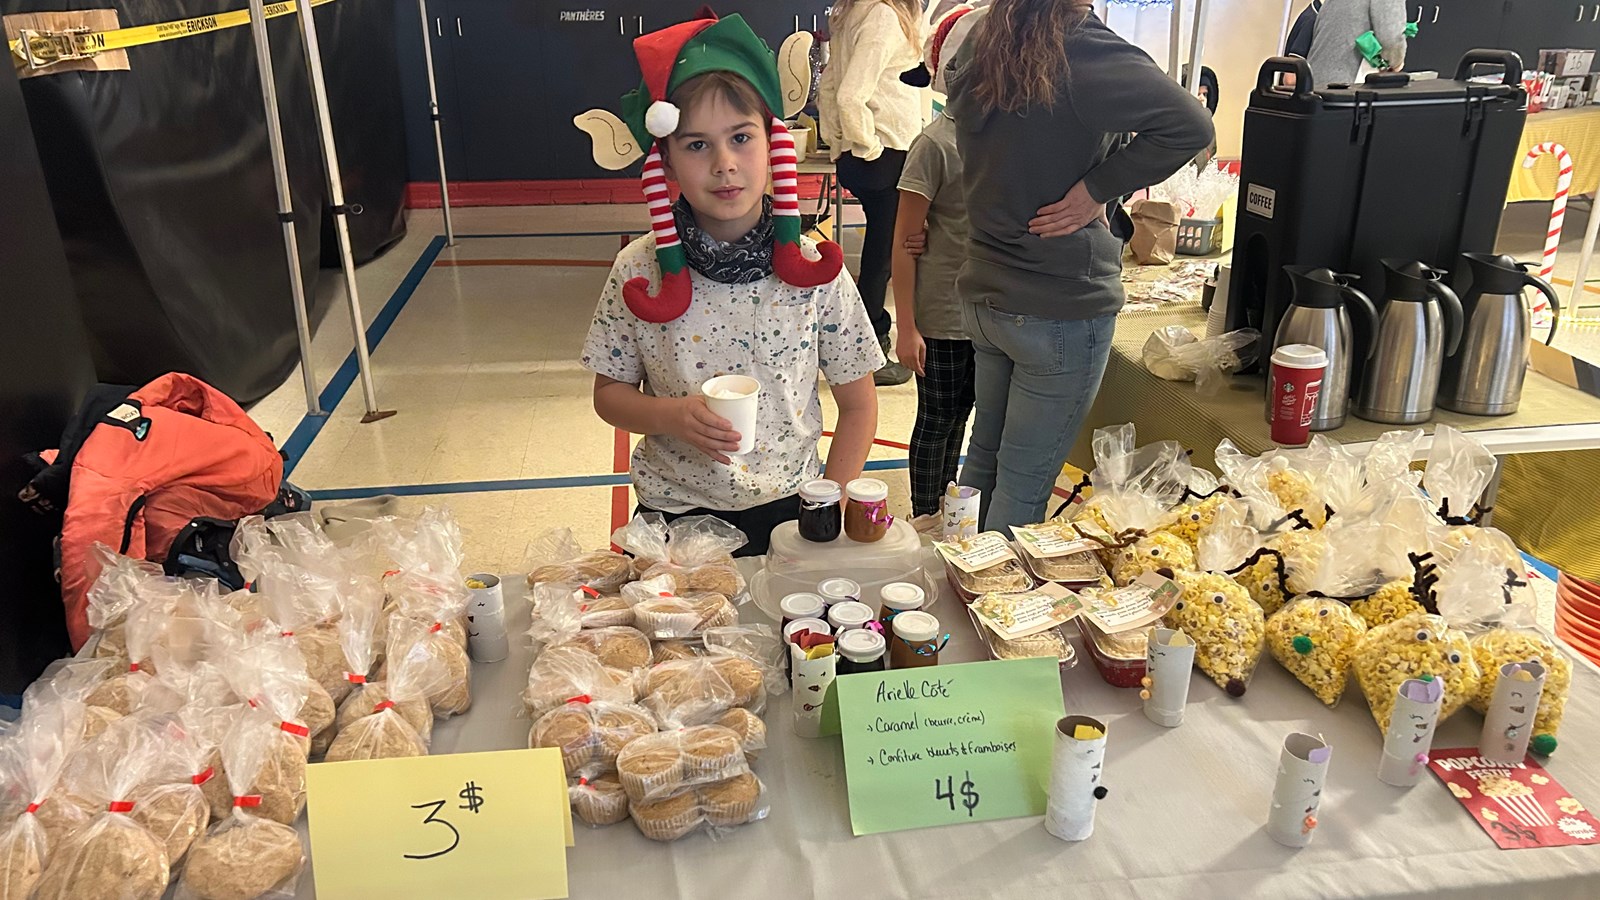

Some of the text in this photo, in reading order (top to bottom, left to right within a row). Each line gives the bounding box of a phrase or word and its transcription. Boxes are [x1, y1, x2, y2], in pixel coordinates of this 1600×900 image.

[186, 16, 218, 33] ERICKSON
[560, 8, 605, 21] PANTHÈRES
[1249, 191, 1273, 210] COFFEE
[876, 679, 919, 703] Arielle
[875, 711, 919, 733] Caramel
[879, 748, 922, 766] Confiture
[935, 770, 980, 817] 4$
[404, 781, 485, 860] 3$
